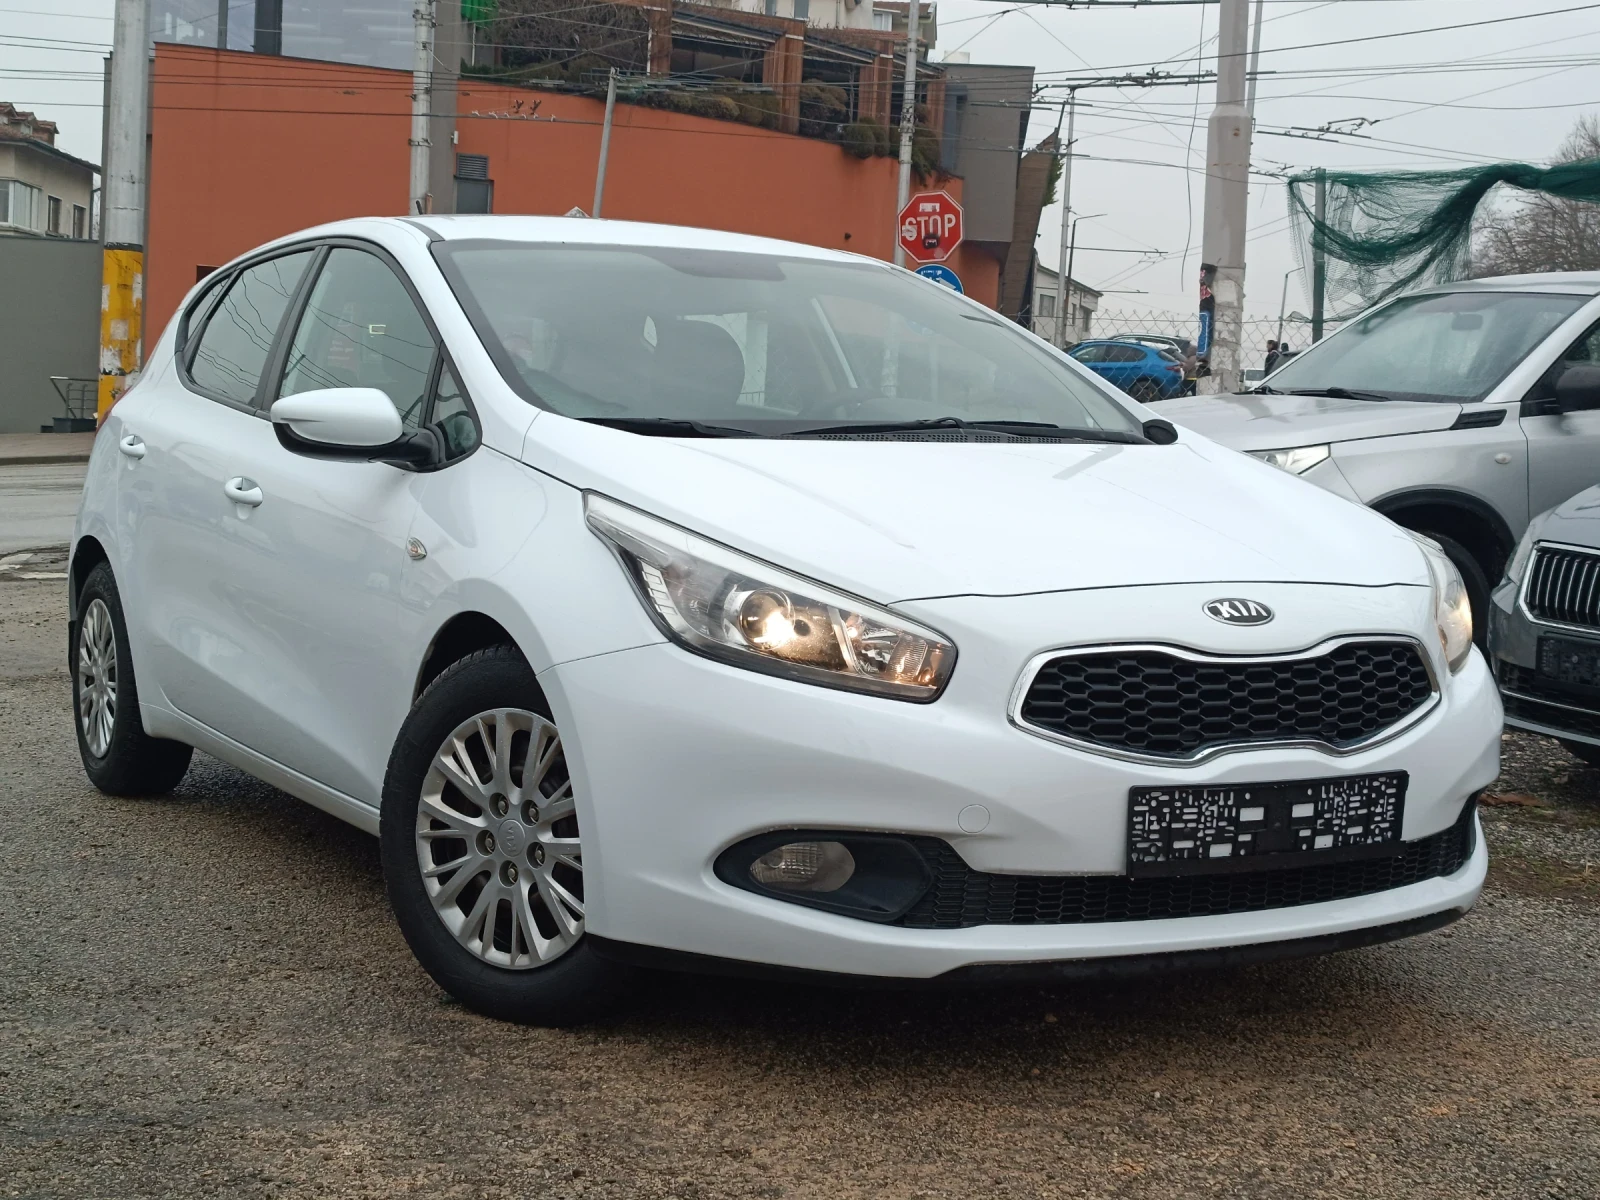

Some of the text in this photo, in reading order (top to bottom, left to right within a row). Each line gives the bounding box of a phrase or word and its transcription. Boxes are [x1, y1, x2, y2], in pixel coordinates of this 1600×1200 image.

[904, 213, 956, 241] STOP
[1208, 600, 1268, 618] KIA
[505, 826, 517, 853] KIA
